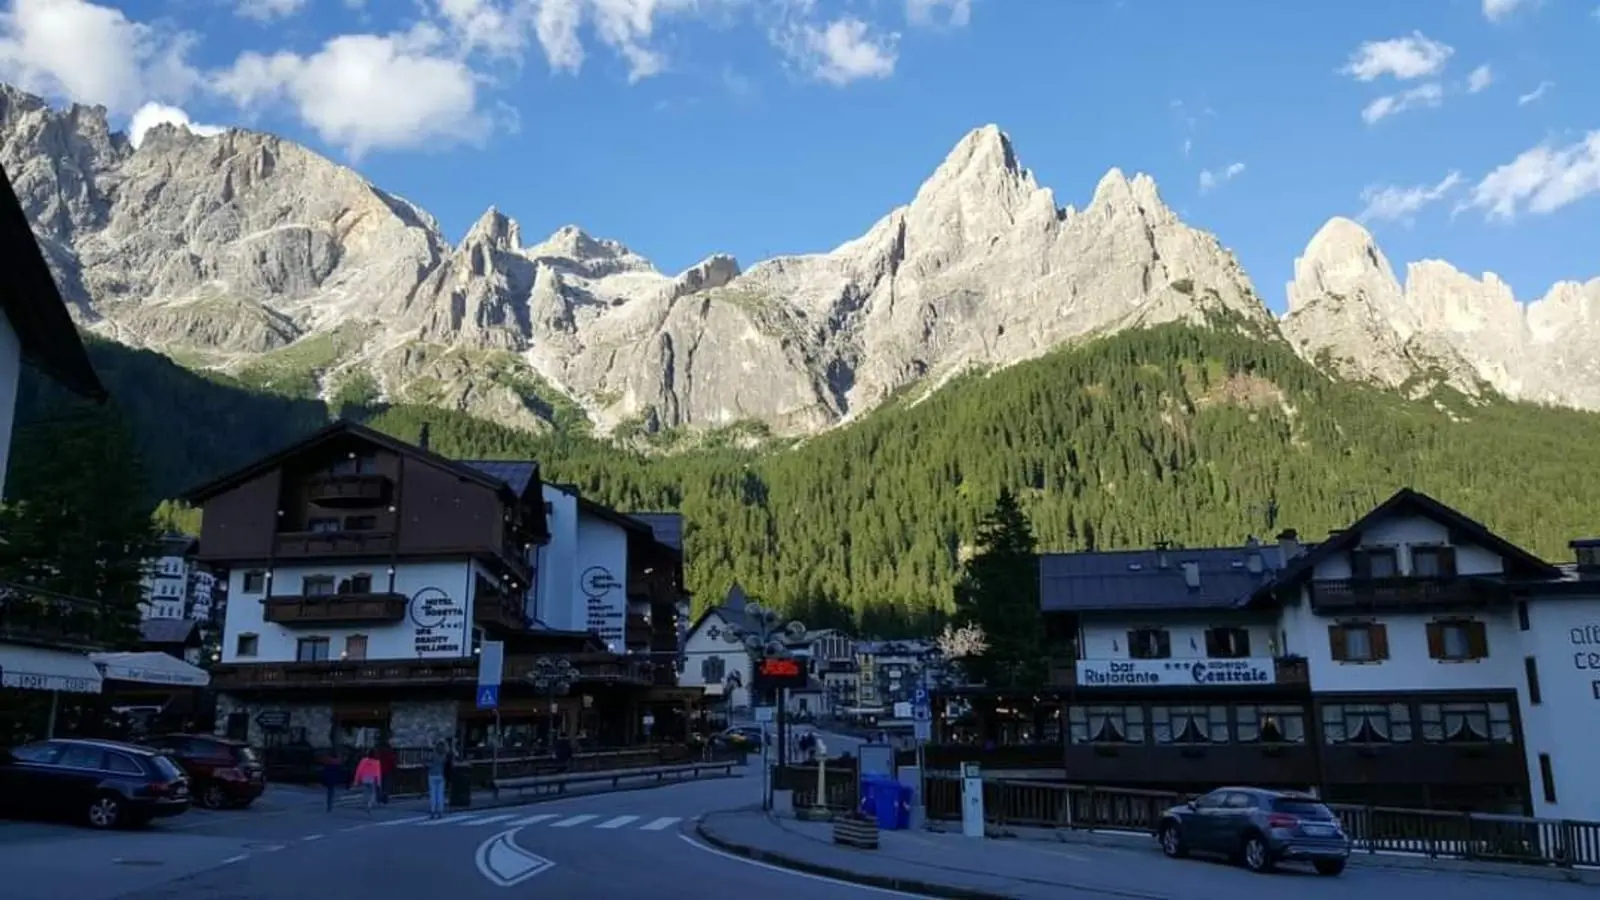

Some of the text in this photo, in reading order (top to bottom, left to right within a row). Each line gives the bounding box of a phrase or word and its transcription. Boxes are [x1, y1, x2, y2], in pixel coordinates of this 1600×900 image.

[425, 598, 454, 606] HOTEL
[1110, 661, 1136, 673] bar
[1191, 660, 1268, 684] Centrale
[1084, 668, 1160, 684] Ristorante
